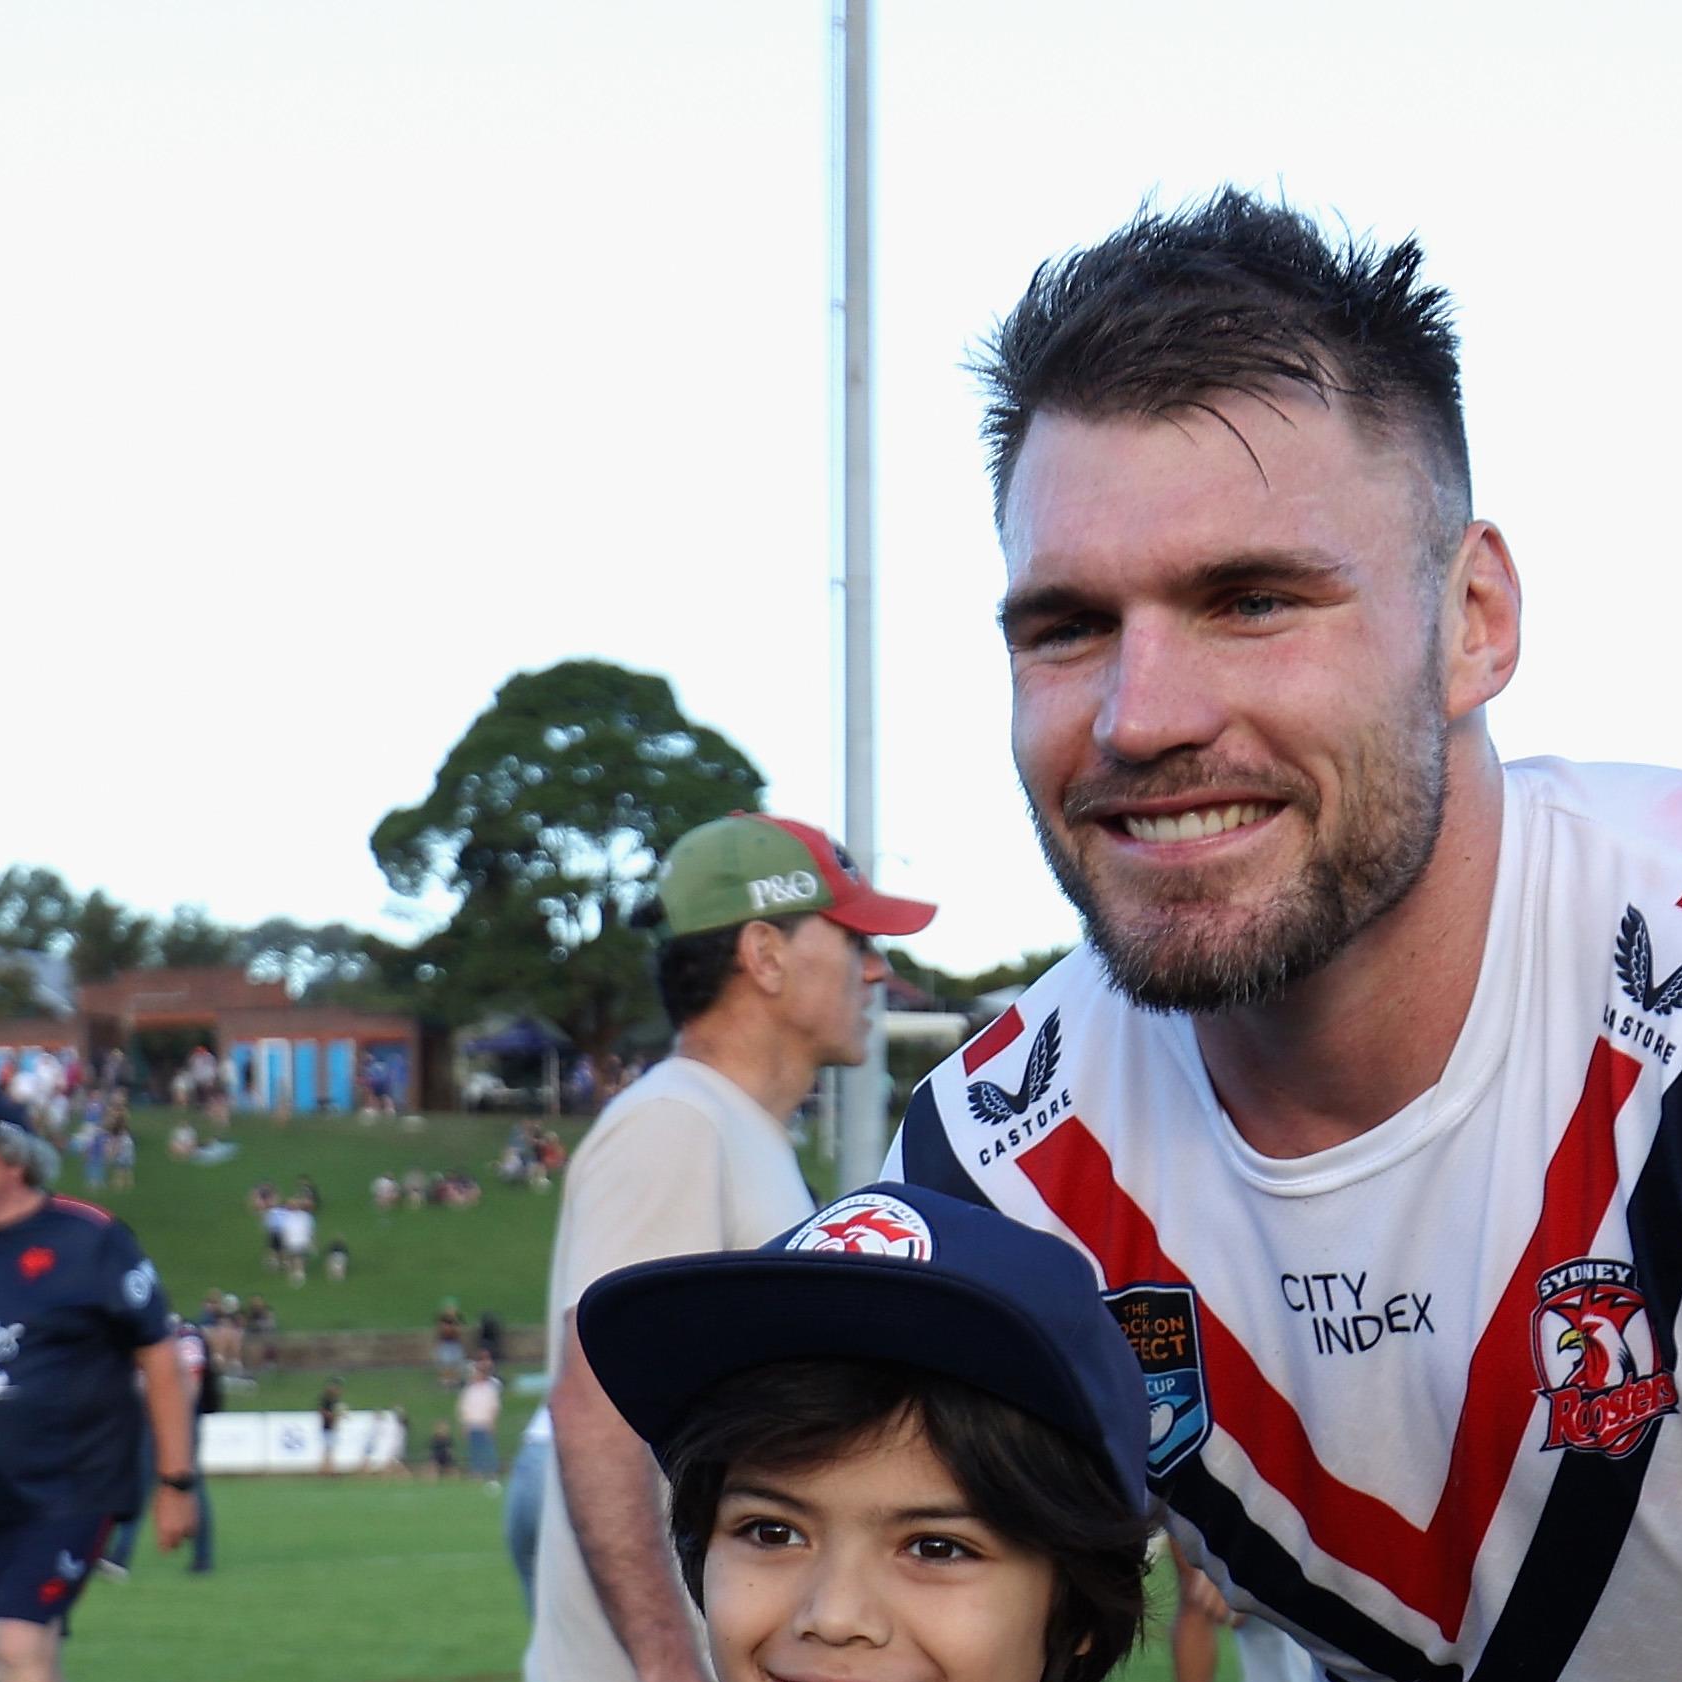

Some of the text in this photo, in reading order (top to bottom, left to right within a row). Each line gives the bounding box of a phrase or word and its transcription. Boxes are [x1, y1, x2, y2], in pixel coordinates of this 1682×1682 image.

[747, 870, 819, 911] P&O
[979, 1088, 1073, 1166] CASTORE
[1280, 1271, 1368, 1313] CITY
[1540, 1263, 1632, 1298] SYDNEY
[1119, 1315, 1186, 1336] OCK-ON
[1123, 1302, 1150, 1317] THE
[1312, 1292, 1435, 1356] INDEX
[1129, 1334, 1187, 1361] FECT
[1146, 1377, 1176, 1395] CUP
[1542, 1371, 1679, 1449] Roosters
